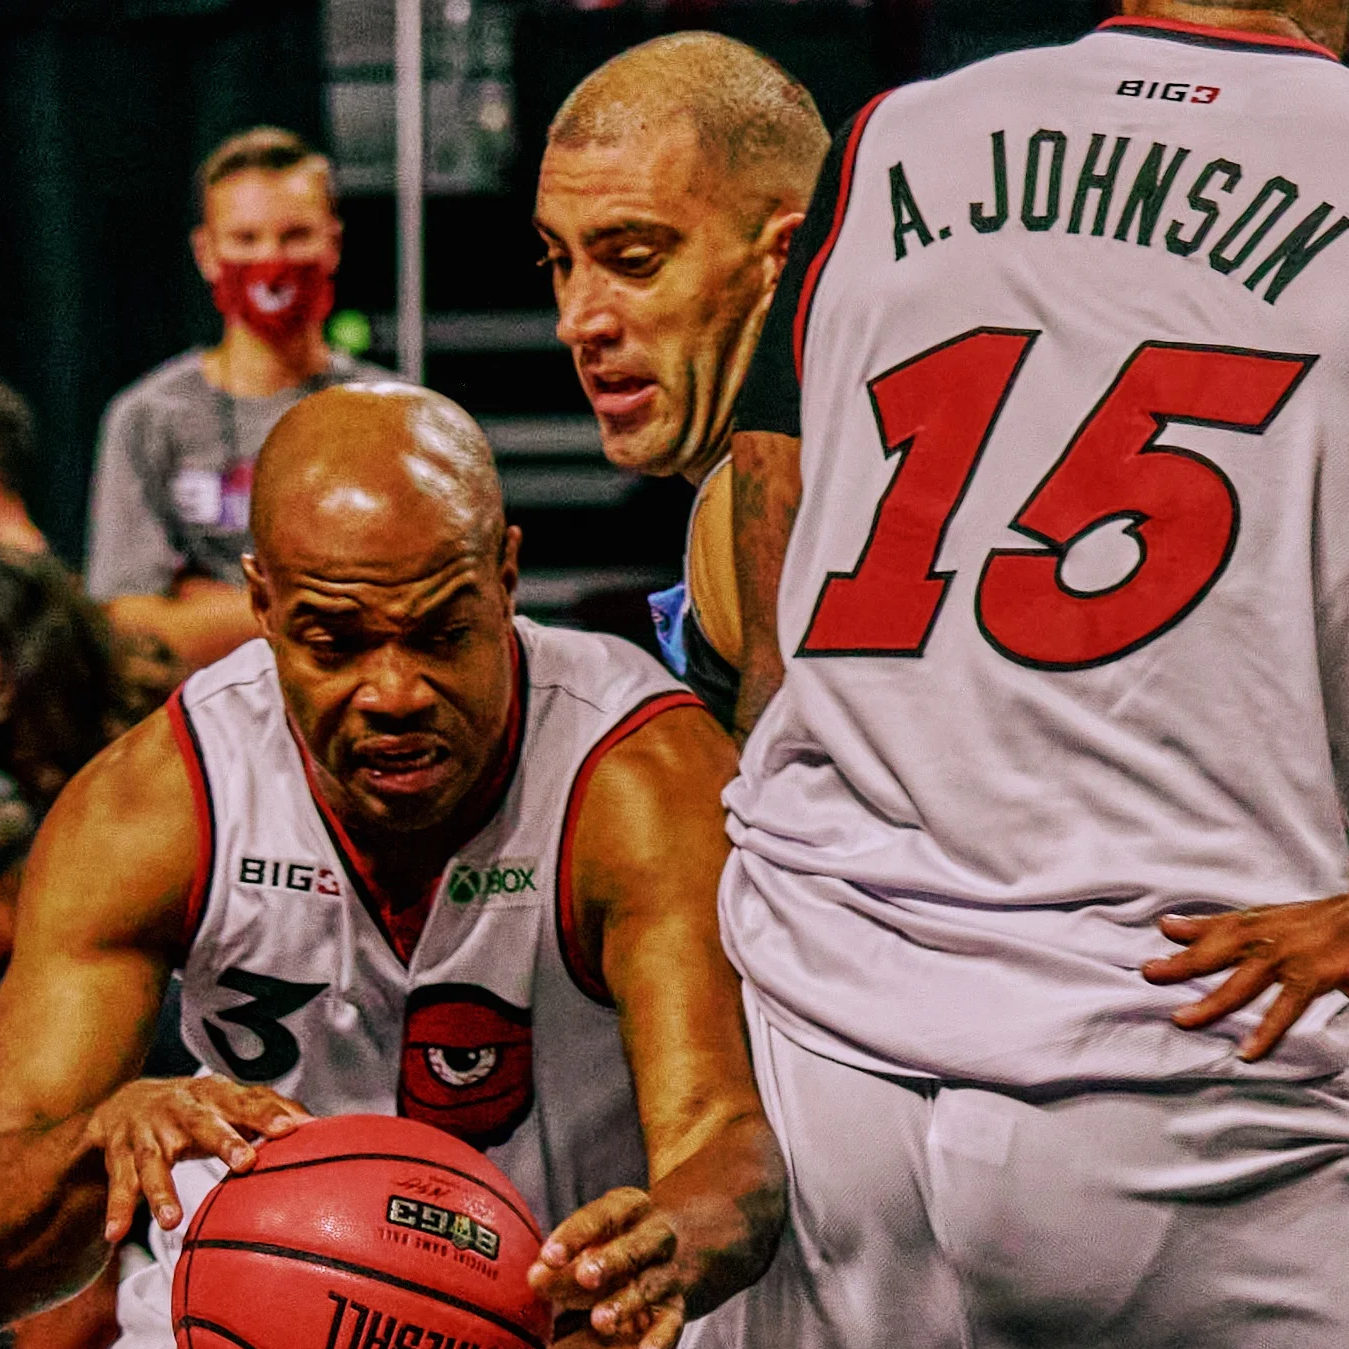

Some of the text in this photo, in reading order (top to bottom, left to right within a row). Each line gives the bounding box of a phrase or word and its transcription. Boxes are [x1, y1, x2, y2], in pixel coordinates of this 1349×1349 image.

[1116, 80, 1221, 104] BIG3
[887, 162, 952, 261] A.
[794, 325, 1320, 672] 15
[239, 857, 341, 897] BIG3
[202, 966, 331, 1082] 3
[377, 1227, 411, 1245] BALL
[415, 1236, 447, 1257] GAME
